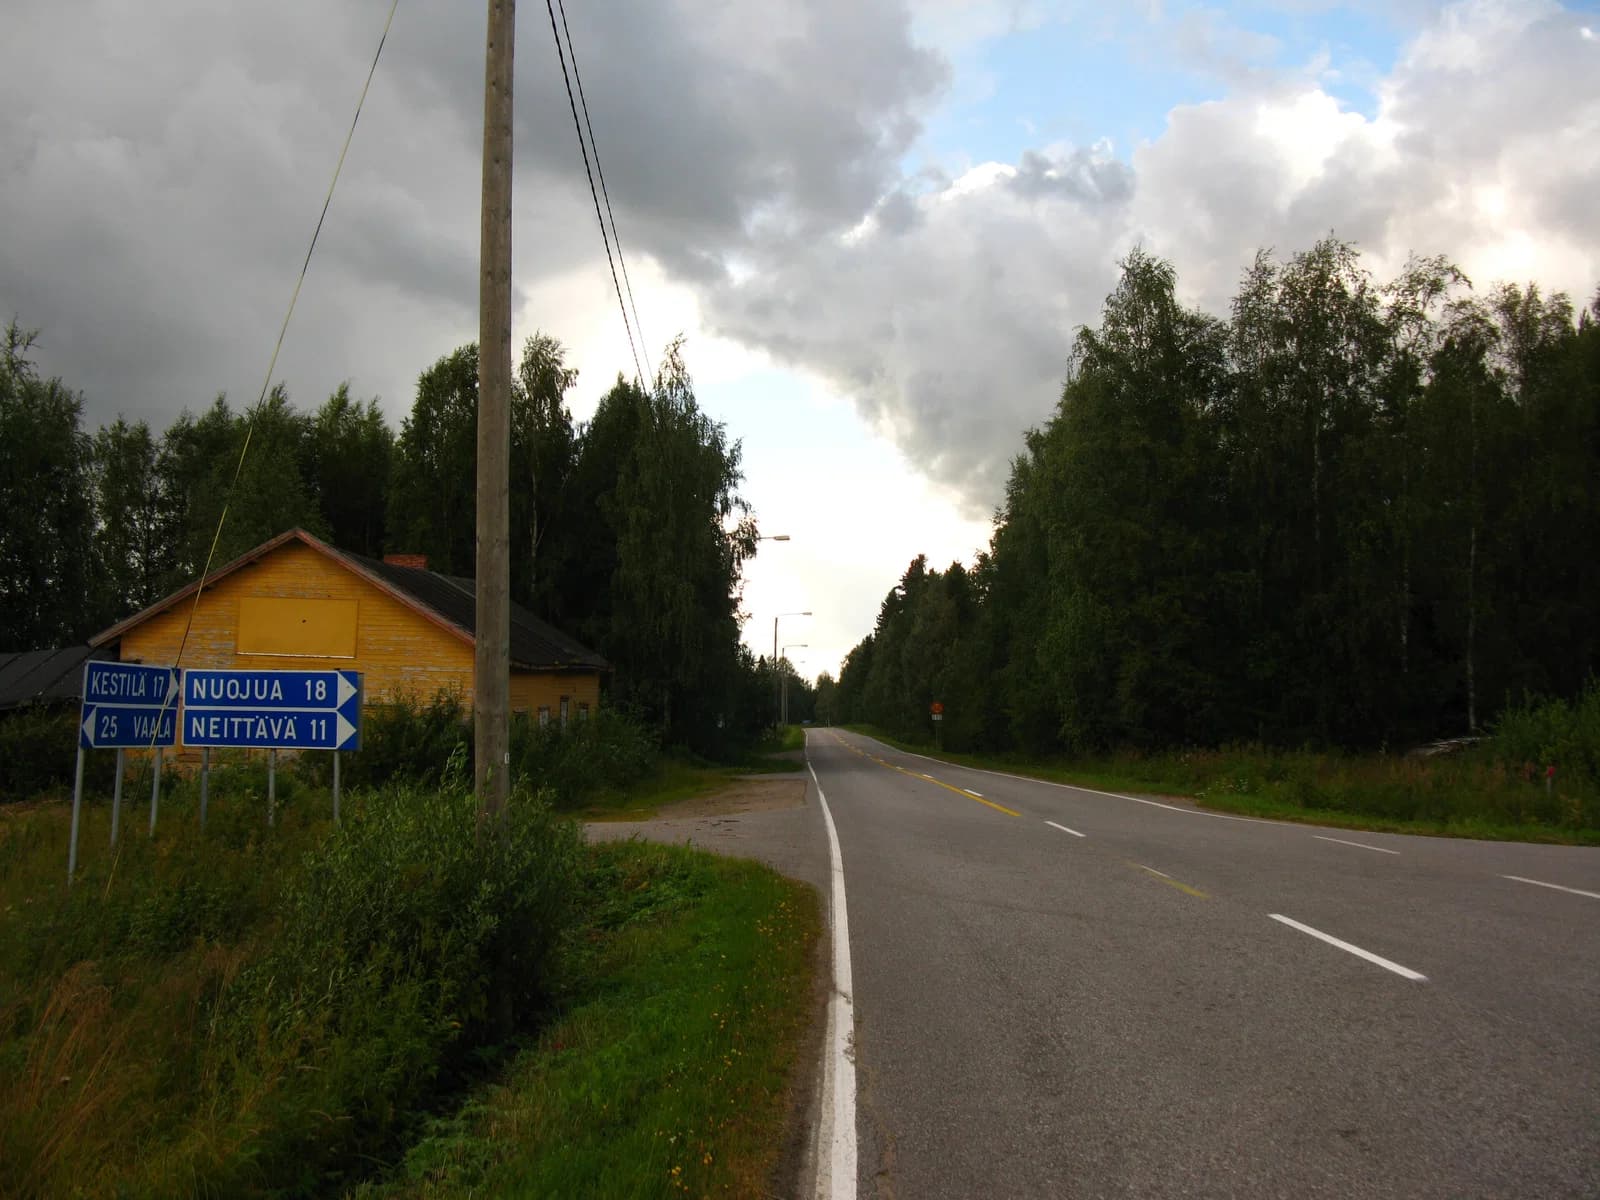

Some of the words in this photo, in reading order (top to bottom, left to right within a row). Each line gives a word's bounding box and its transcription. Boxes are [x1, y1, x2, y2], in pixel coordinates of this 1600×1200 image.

[91, 671, 146, 697] KESTILÄ
[153, 676, 164, 698] 17
[193, 678, 283, 701] NUOJUA
[305, 680, 327, 701] 18
[101, 715, 118, 738] 25
[134, 715, 171, 738] VAALA
[191, 715, 298, 740] NEITTÄVÄ
[310, 719, 327, 741] 11
